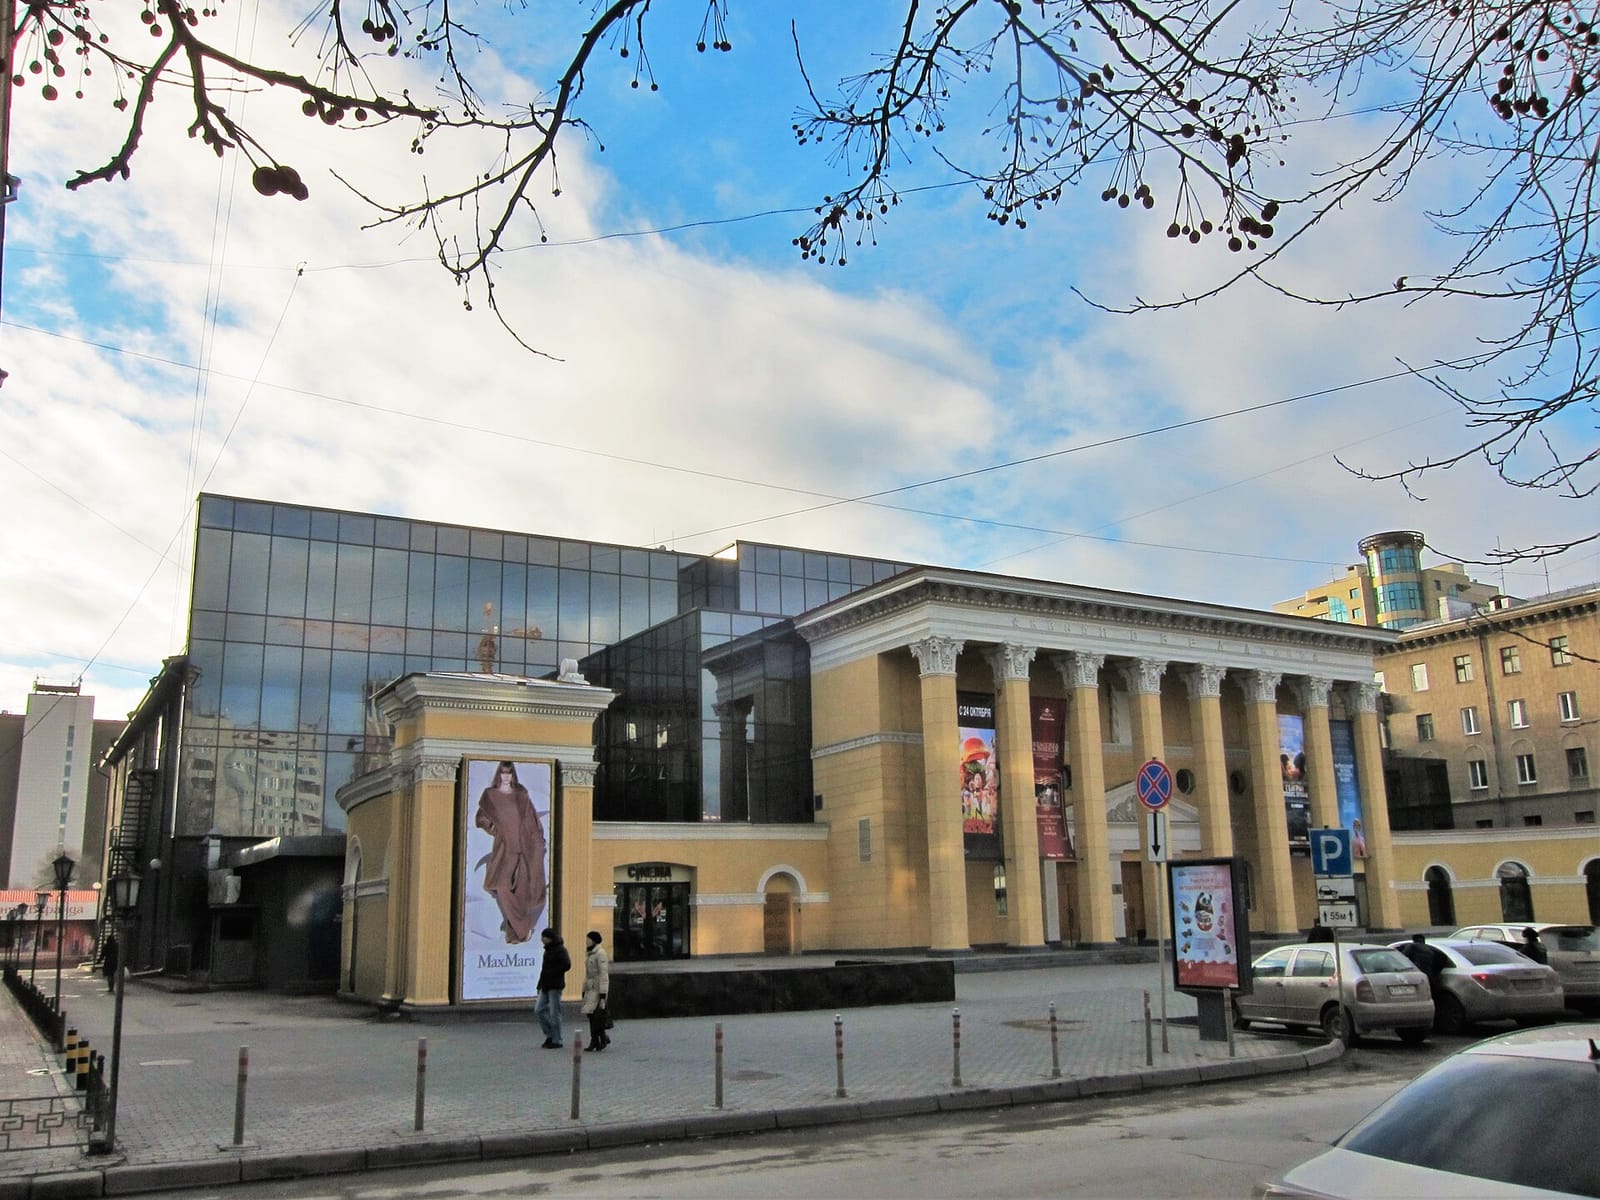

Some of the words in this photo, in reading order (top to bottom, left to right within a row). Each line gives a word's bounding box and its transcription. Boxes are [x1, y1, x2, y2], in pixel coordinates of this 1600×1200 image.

[970, 707, 992, 718] ОКТЯБРЯ
[1320, 835, 1342, 872] P
[478, 953, 535, 968] MaxMara
